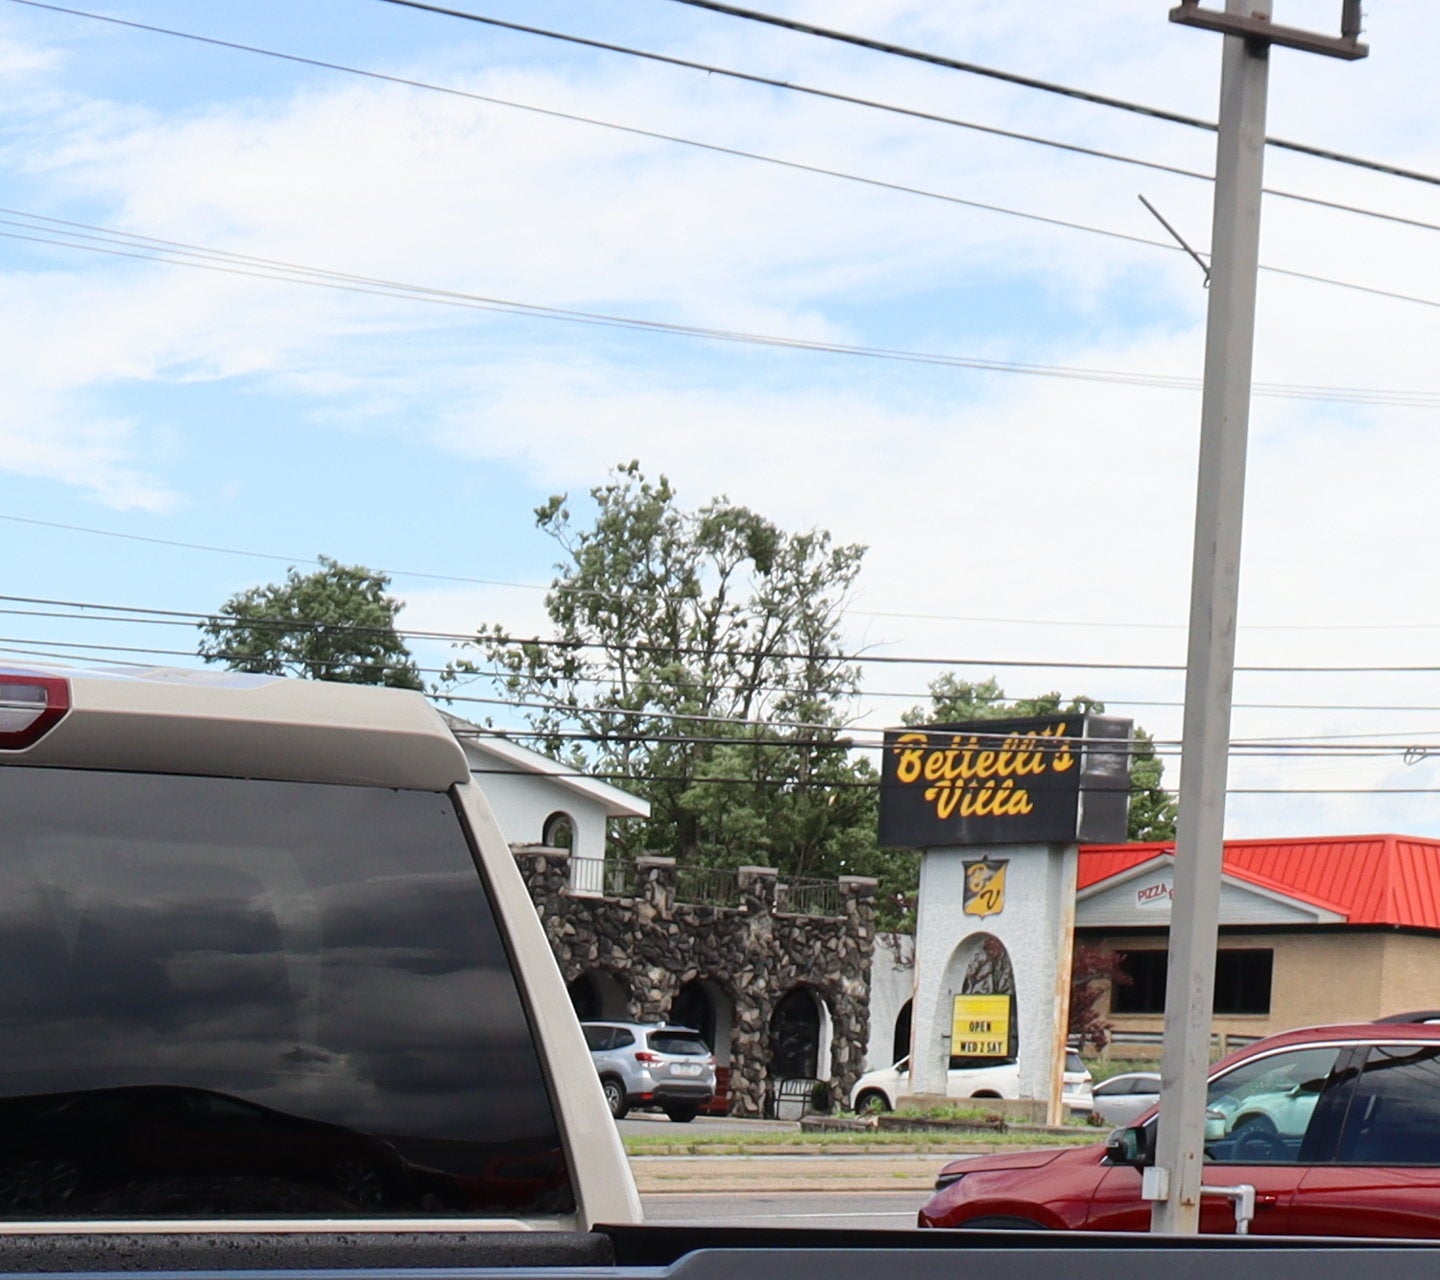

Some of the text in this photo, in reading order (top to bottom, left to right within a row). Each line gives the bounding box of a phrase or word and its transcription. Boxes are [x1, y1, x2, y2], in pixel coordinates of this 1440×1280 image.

[893, 722, 1075, 783] Bettelli's
[924, 778, 1033, 819] Villa
[1137, 883, 1167, 902] PIZZA
[969, 1021, 992, 1032] OPEN
[960, 1041, 978, 1053] WED
[987, 1041, 1002, 1053] SAT
